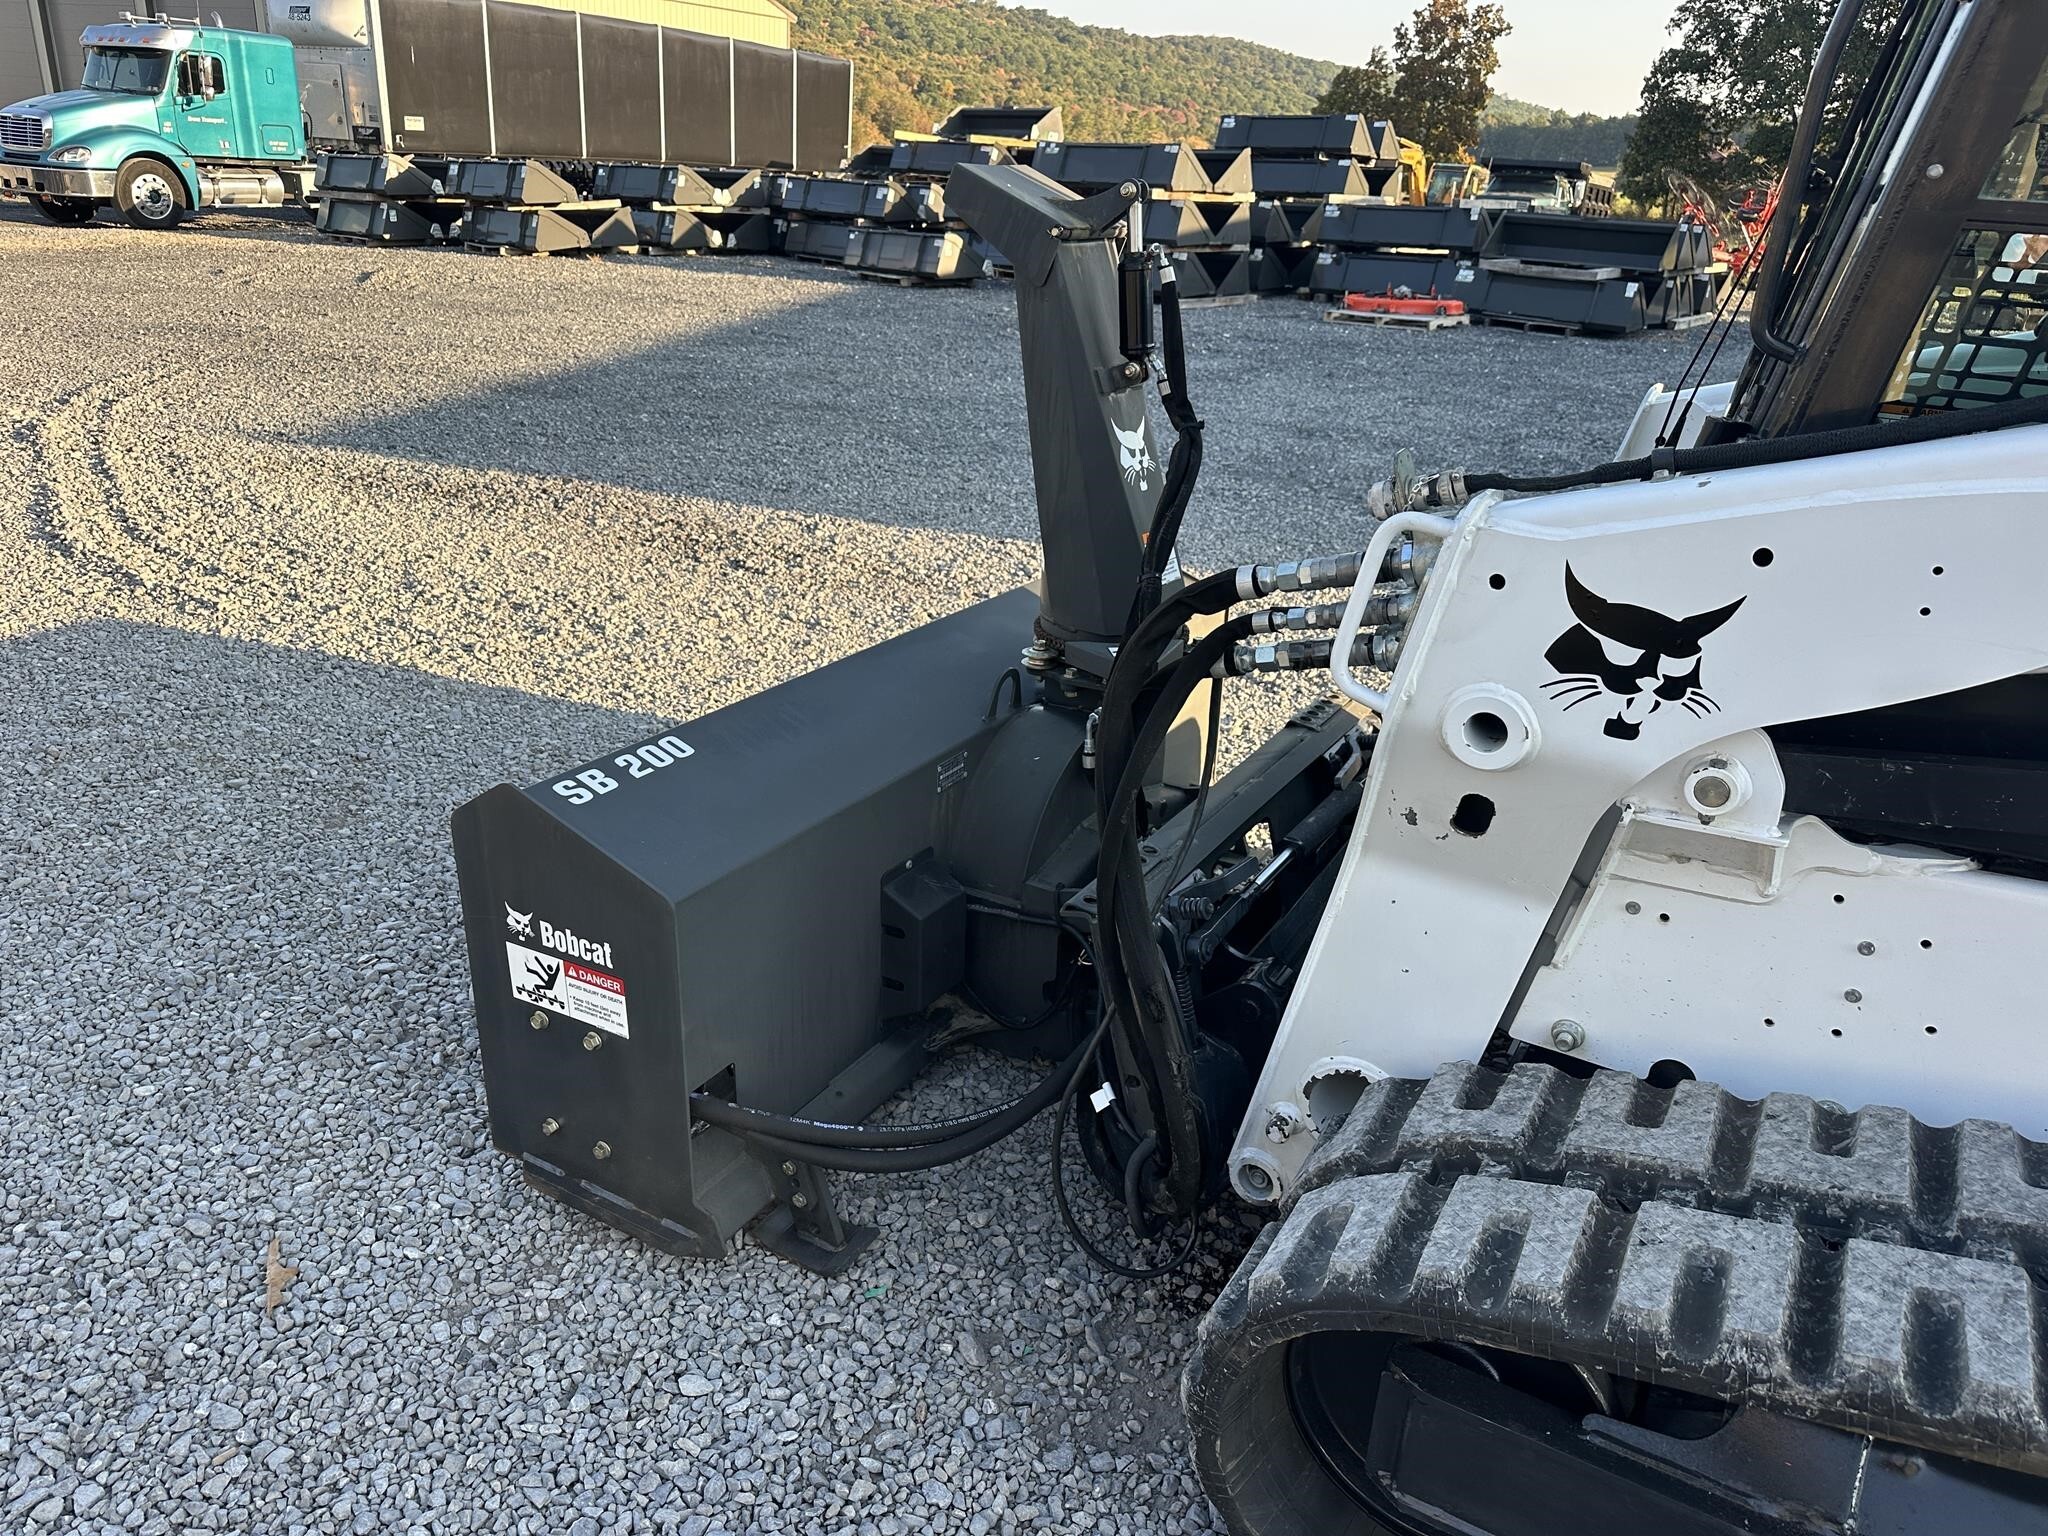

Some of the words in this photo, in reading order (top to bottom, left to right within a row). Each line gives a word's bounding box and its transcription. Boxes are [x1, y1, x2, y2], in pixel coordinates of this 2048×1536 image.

[552, 768, 619, 805] SB
[614, 735, 695, 779] 200
[539, 920, 614, 969] Bobcat
[579, 970, 621, 992] DANGER
[568, 982, 582, 991] AVOID
[583, 987, 599, 996] INJURY
[608, 995, 623, 1004] DEATH
[574, 1007, 598, 1018] attachment
[599, 1015, 610, 1023] when
[584, 1004, 602, 1014] machine
[610, 1009, 621, 1017] away
